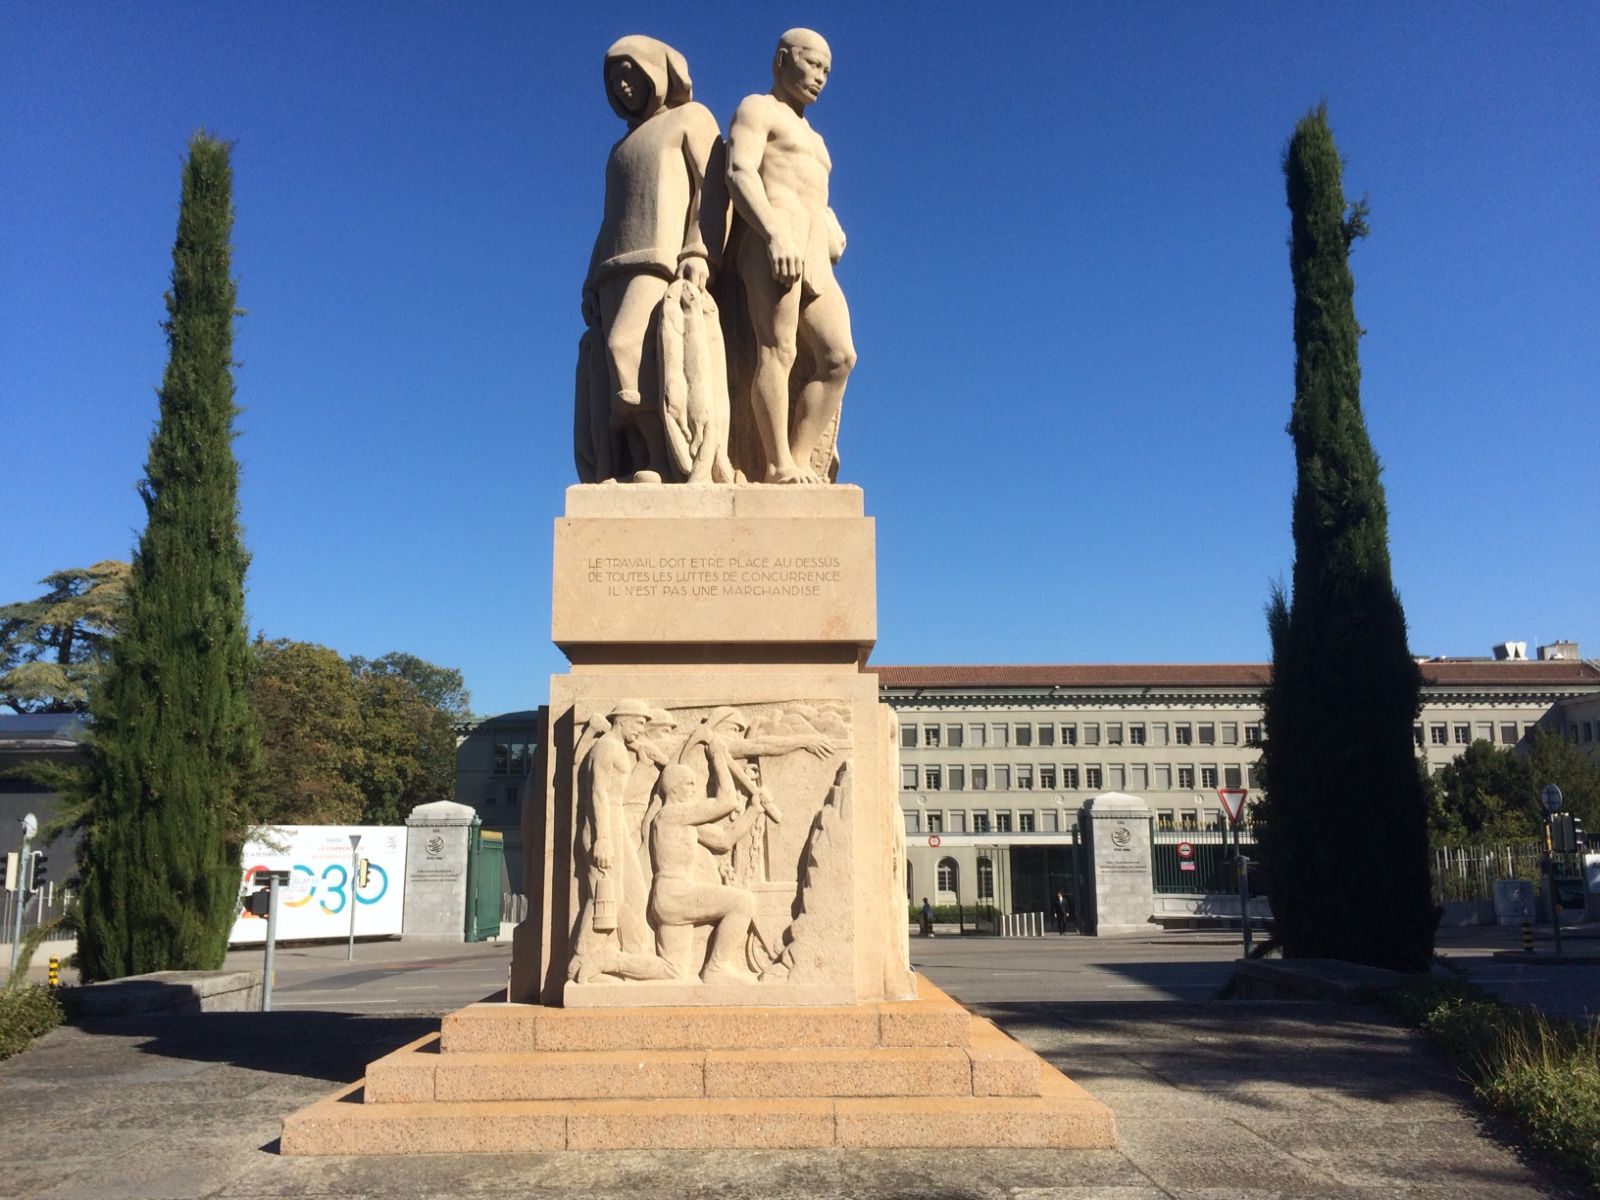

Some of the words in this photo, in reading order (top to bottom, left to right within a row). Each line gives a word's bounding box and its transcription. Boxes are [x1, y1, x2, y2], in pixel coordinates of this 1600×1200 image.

[588, 558, 602, 568] LE
[606, 558, 655, 568] TRAVAIL
[659, 558, 686, 568] DOIT
[691, 558, 724, 568] ETRE
[728, 557, 769, 568] PLACE
[774, 557, 792, 568] AU
[795, 557, 840, 568] DESSUS
[588, 572, 602, 582] DE
[606, 572, 650, 582] TOUTES
[653, 572, 673, 582] LES
[676, 572, 719, 582] LUTTES
[722, 572, 737, 582] DE
[741, 572, 840, 582] CONCURRENCE
[608, 586, 620, 596] IL
[625, 586, 658, 596] N'EST
[663, 586, 688, 596] PAS
[692, 586, 718, 596] UNE
[722, 586, 821, 596] MARCHANDISE
